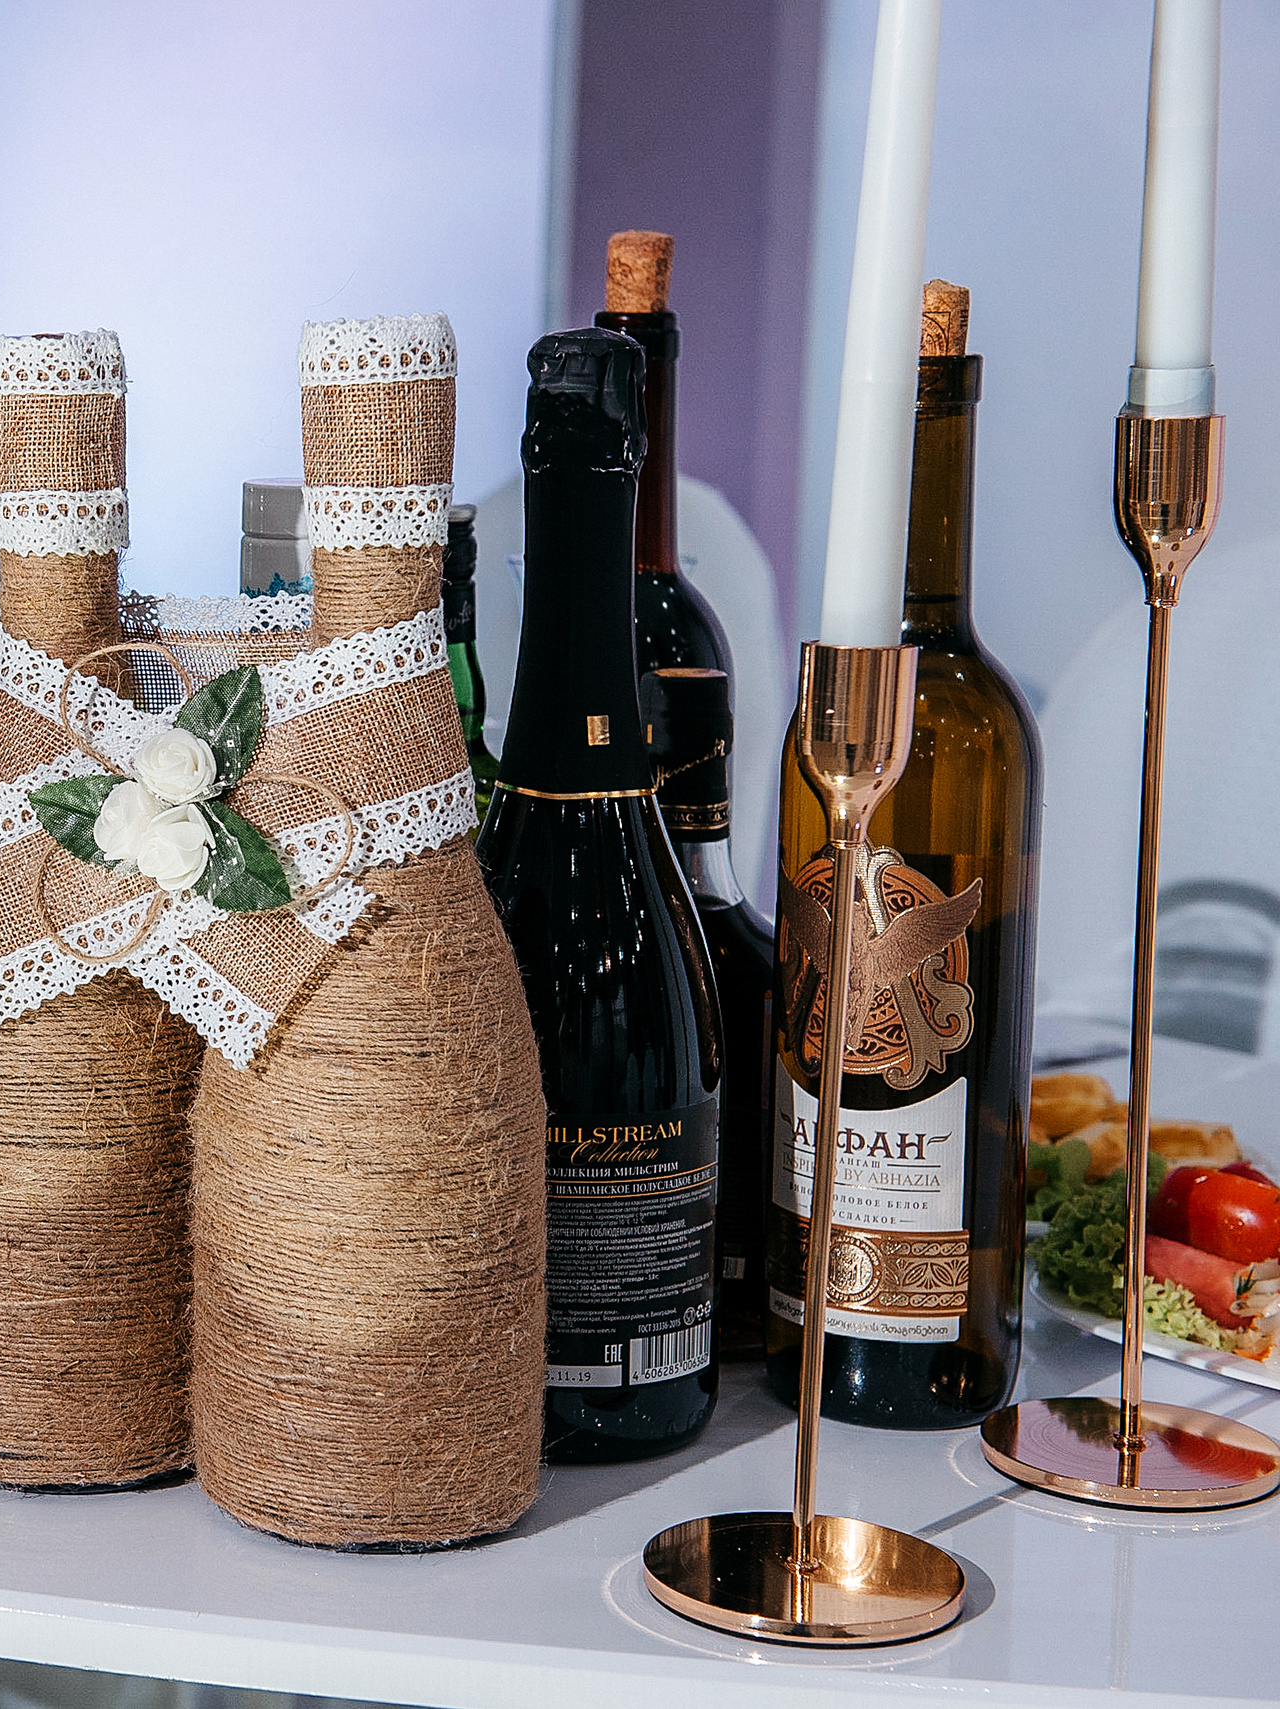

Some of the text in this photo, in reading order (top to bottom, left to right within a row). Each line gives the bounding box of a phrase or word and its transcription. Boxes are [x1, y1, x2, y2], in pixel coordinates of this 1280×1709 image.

[794, 1116, 927, 1160] АФАН
[570, 1139, 660, 1166] Collection
[548, 1161, 679, 1178] ОЛЛЕКЦИЯ МИЛЬСТРИМ
[783, 1152, 941, 1187] INSPI BY ABHAZIA
[834, 1157, 880, 1169] АНГАШ
[556, 1184, 630, 1195] ШАМПАНСКОЕ
[632, 1174, 692, 1193] ПОЛУСЛАДКОЕ
[833, 1194, 880, 1207] ОЛОВОЕ
[887, 1200, 929, 1210] БЕЛОЕ
[831, 1209, 896, 1225] УСЛАДКОЕ
[632, 1371, 639, 1380] 4
[645, 1363, 679, 1379] 606285
